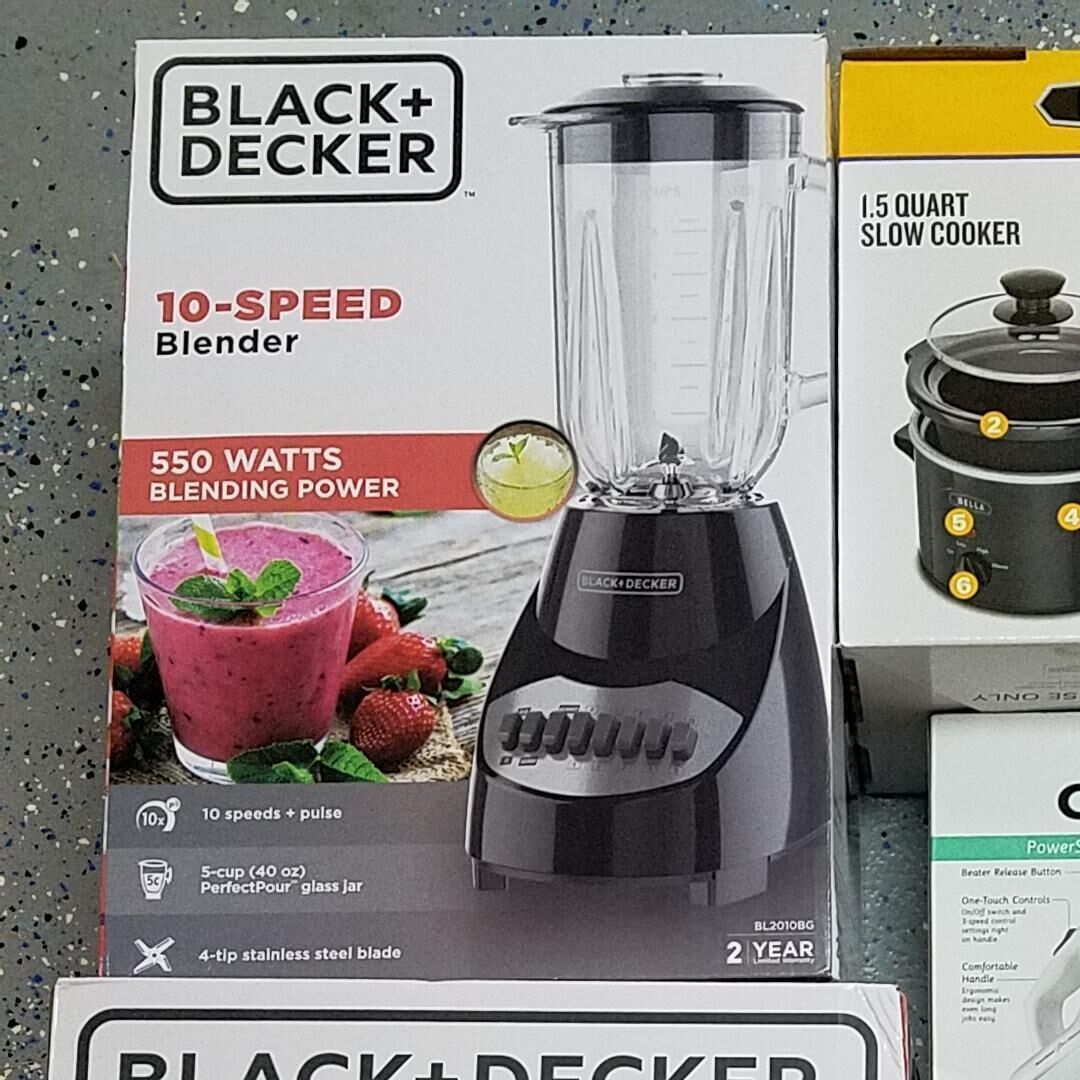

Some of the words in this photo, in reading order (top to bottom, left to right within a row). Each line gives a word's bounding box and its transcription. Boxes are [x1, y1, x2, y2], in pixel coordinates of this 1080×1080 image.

[182, 83, 432, 126] BLACK+
[181, 133, 435, 177] DECKER
[861, 194, 888, 219] 1.5
[894, 192, 969, 218] QUART
[861, 223, 926, 247] SLOW
[930, 221, 1020, 246] COOKER
[156, 287, 402, 323] 10-SPEED
[156, 328, 299, 356] Blender
[150, 450, 212, 475] 550
[224, 447, 341, 472] WATTS
[149, 480, 289, 502] BLENDING
[297, 478, 399, 500] POWER
[582, 576, 678, 590] BLACK+DECKER
[972, 692, 1039, 701] ONLY
[202, 808, 220, 820] 10
[225, 807, 281, 820] speeds
[300, 807, 342, 820] pulse
[201, 866, 244, 880] 5-cup
[249, 865, 276, 878] (40
[281, 866, 306, 878] oz)
[962, 868, 990, 876] Beater
[995, 868, 1027, 876] Release
[1031, 868, 1061, 876] Button
[301, 880, 339, 895] glass
[342, 880, 363, 894] jar
[962, 896, 1009, 904] One-Touch
[1013, 896, 1050, 904] Controls
[755, 921, 814, 931] BL2010BG
[199, 949, 237, 963] 4-tip
[242, 948, 310, 962] stainless
[314, 947, 352, 960] steel
[358, 946, 401, 959] blade
[726, 942, 742, 964] 2
[753, 941, 814, 957] YEAR
[962, 962, 1018, 973] Comfortable
[962, 975, 994, 983] Handle
